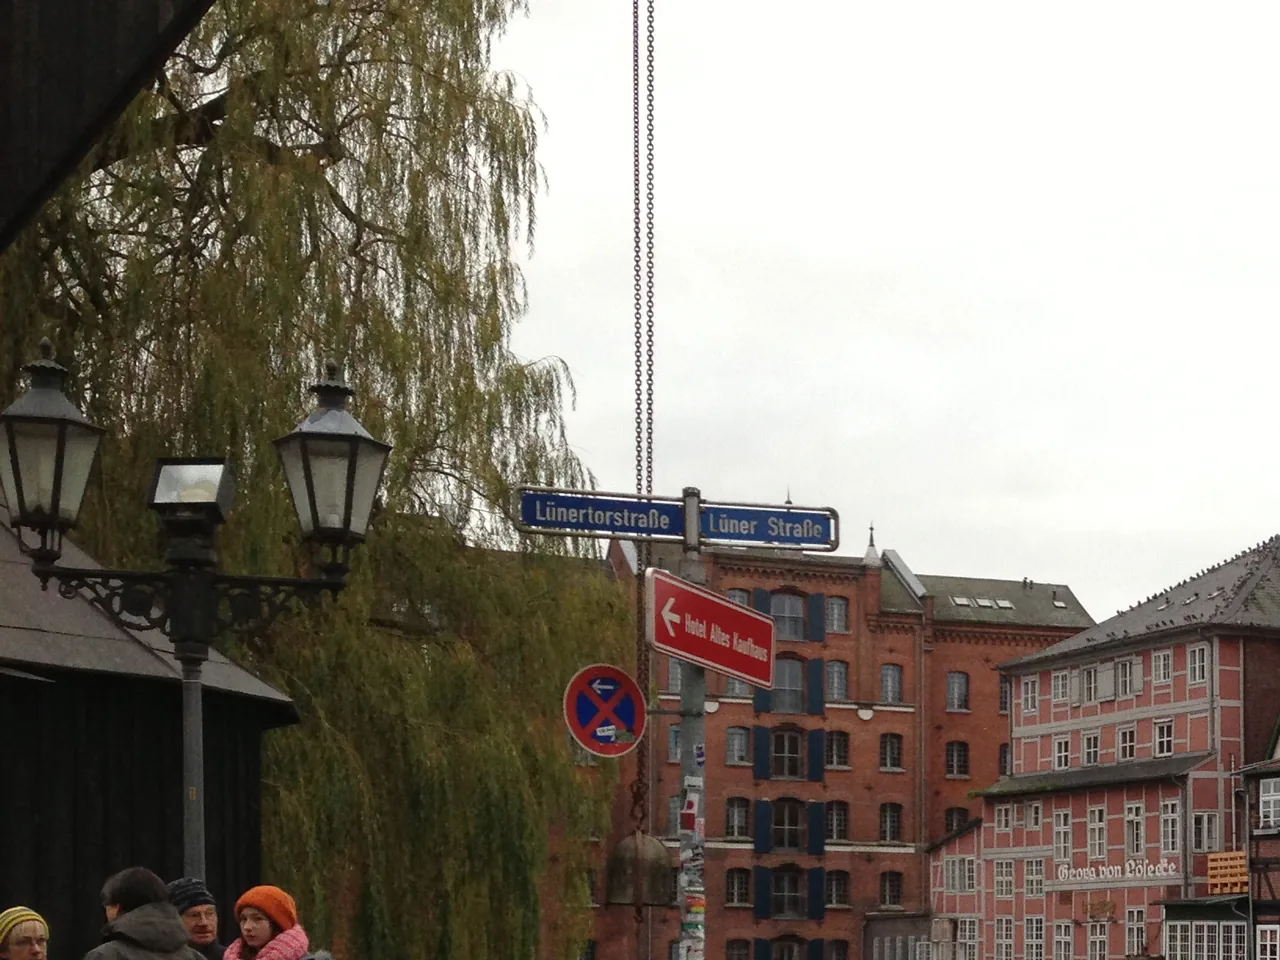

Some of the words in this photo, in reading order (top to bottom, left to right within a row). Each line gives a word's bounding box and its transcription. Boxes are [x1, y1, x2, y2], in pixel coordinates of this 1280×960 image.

[535, 500, 670, 529] Lünertorstraße
[709, 513, 757, 535] Lüner
[767, 516, 823, 538] Straße
[685, 612, 707, 639] Hotel
[710, 622, 730, 648] Altes
[733, 631, 768, 662] Kaufhaus
[1058, 864, 1097, 882] Georg
[1099, 864, 1122, 879] von
